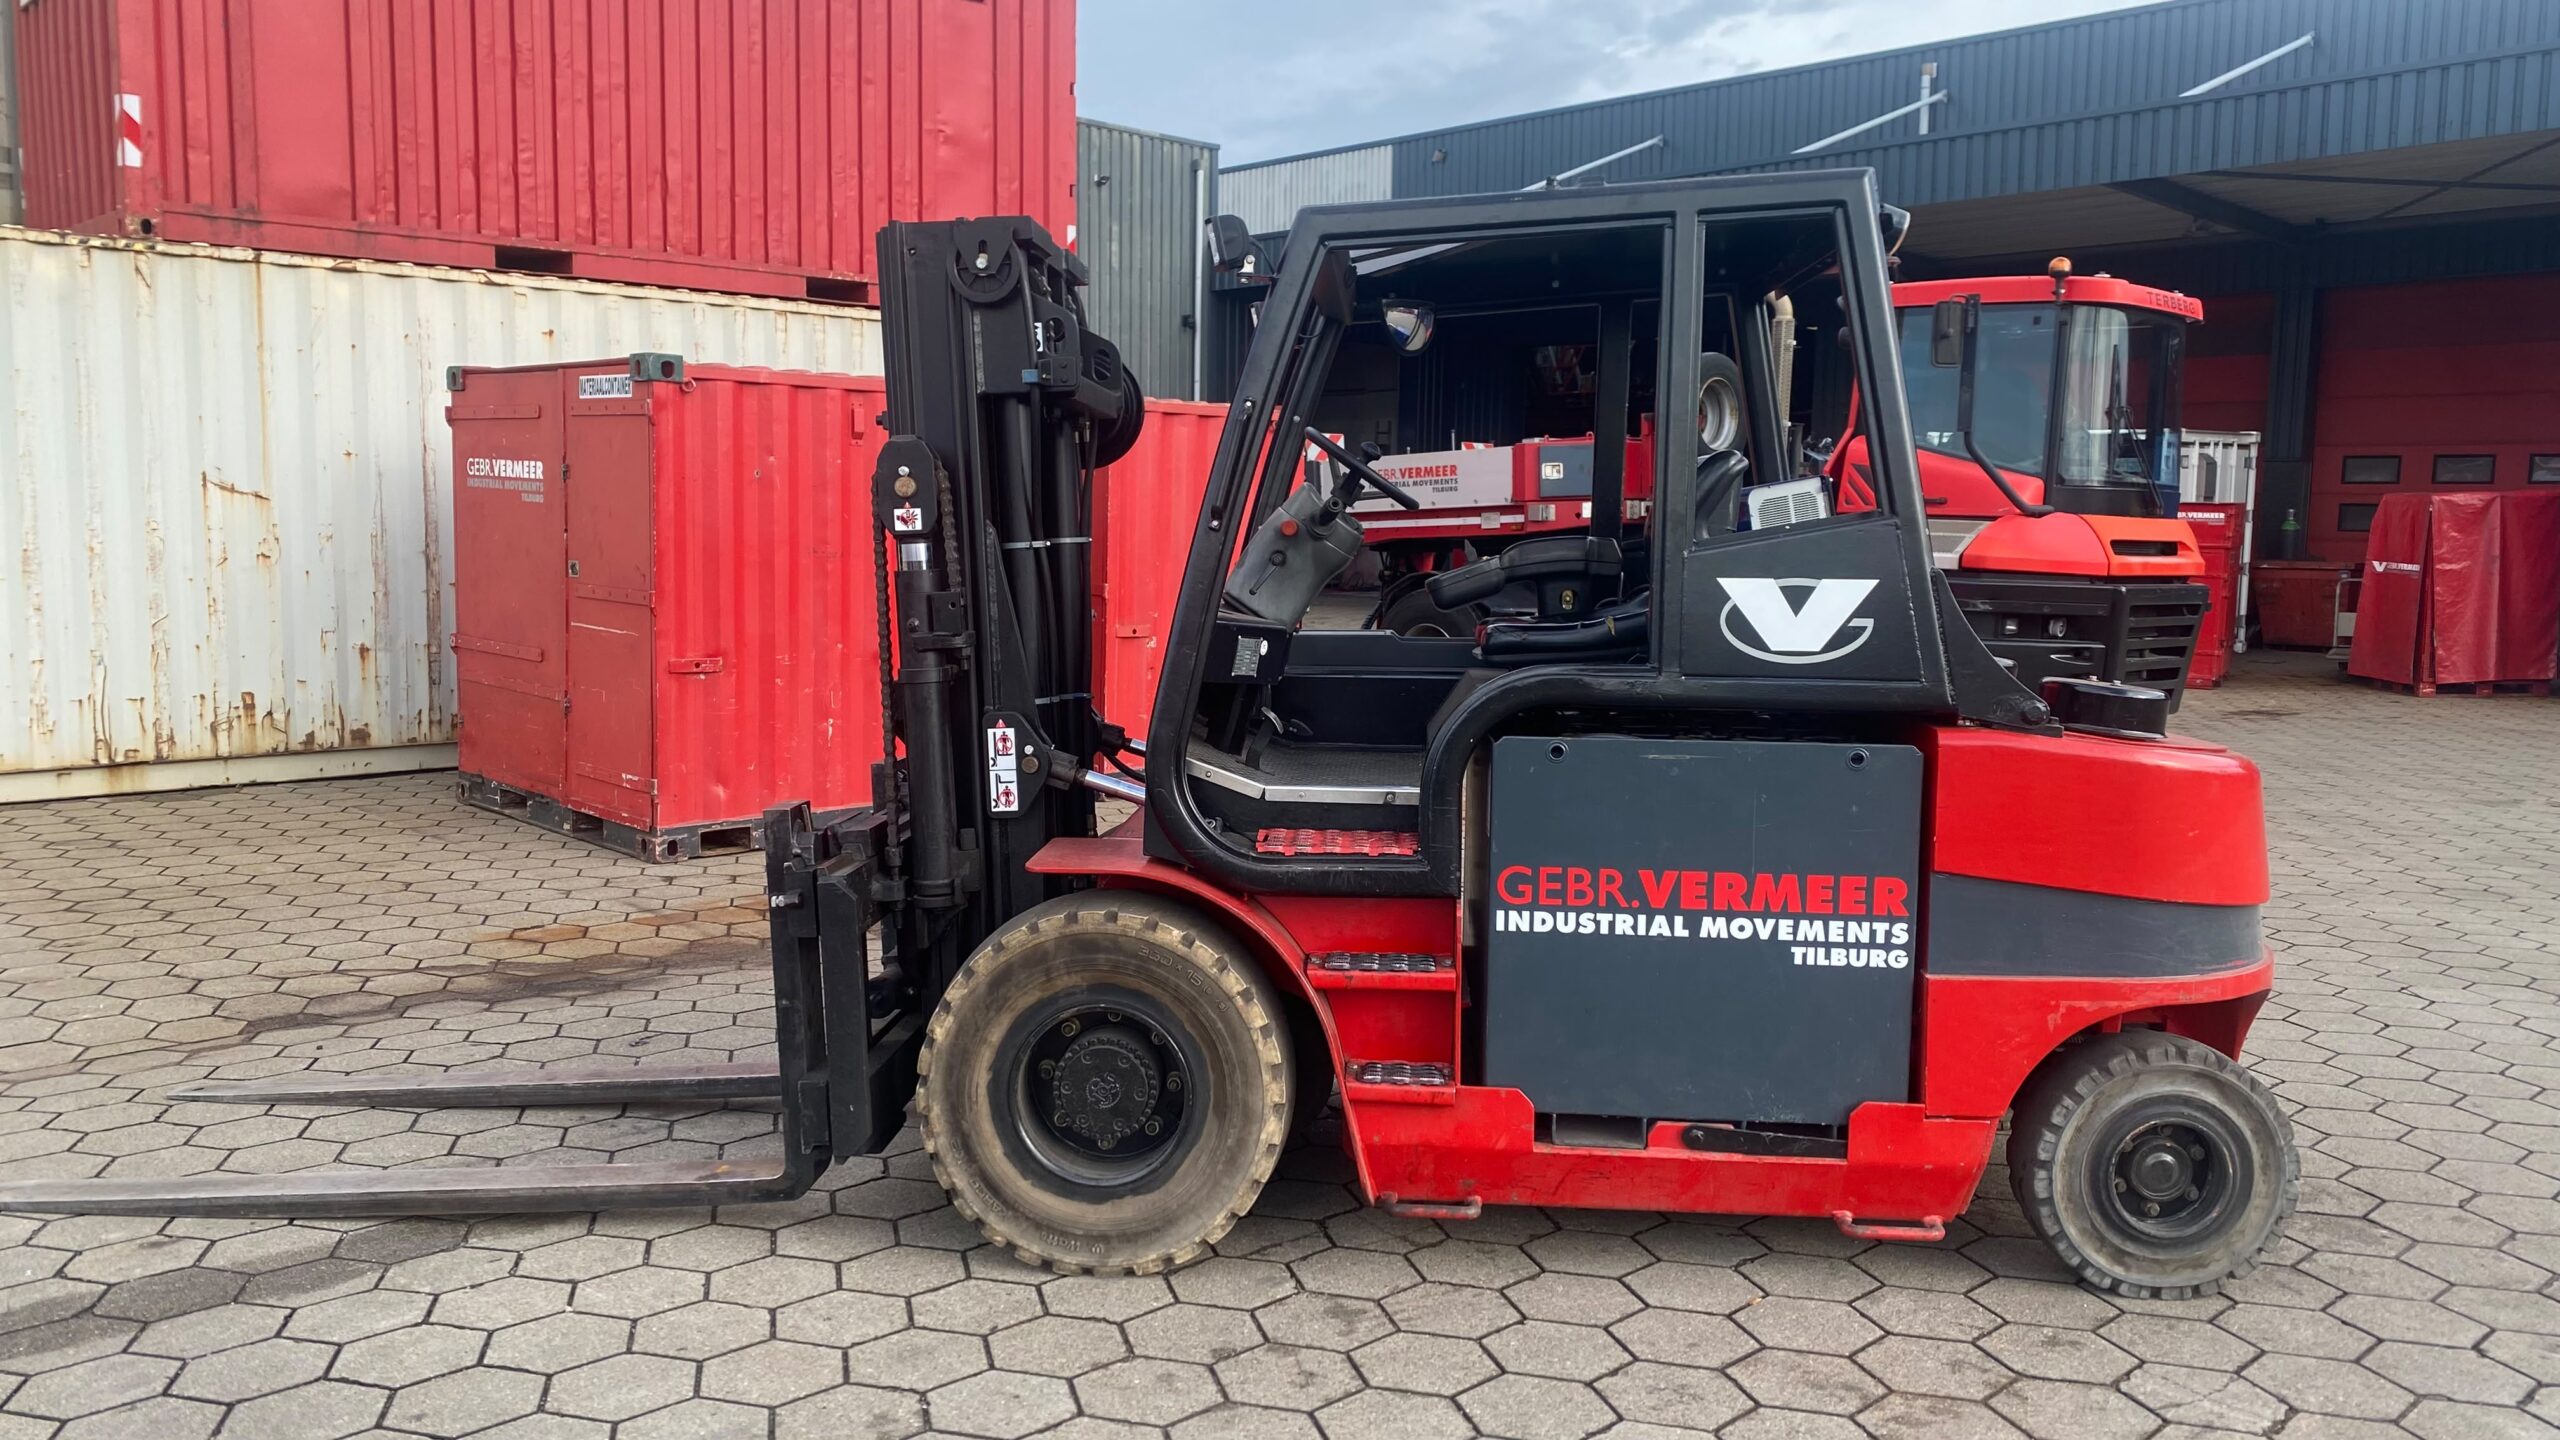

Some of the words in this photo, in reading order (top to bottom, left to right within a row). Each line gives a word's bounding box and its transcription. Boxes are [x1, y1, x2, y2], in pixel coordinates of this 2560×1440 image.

[2146, 291, 2195, 314] TERBERG
[467, 477, 503, 489] INDUSTRIAL
[504, 480, 544, 492] MOVEMENTS
[1412, 478, 1458, 487] MOVEMENTS
[1496, 866, 1910, 917] GEBR.VERMEER
[1496, 910, 1690, 938] INDUSTRIAL
[1699, 916, 1910, 944] MOVEMENTS
[1791, 946, 1910, 969] TILBURG
